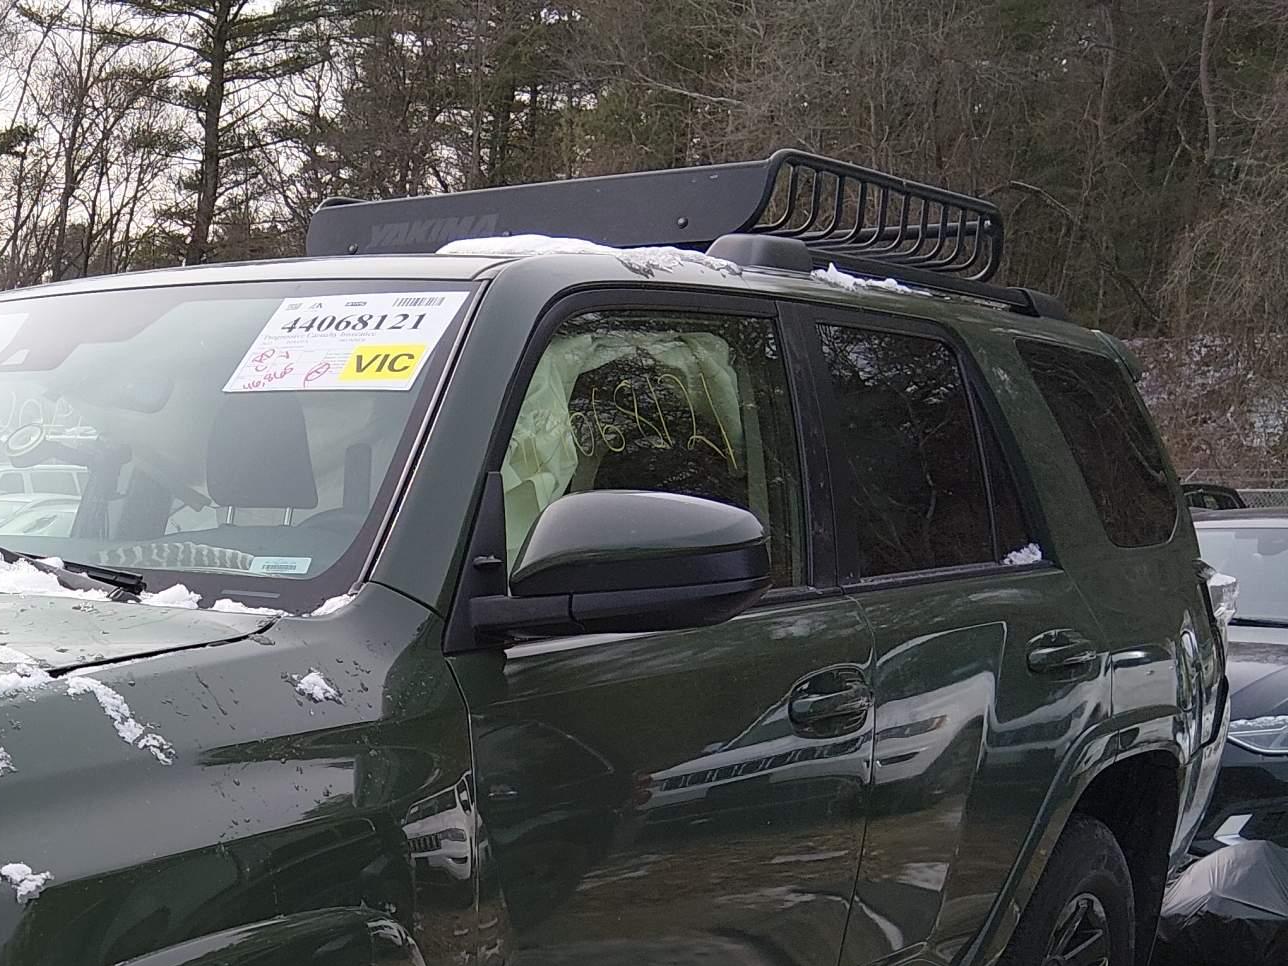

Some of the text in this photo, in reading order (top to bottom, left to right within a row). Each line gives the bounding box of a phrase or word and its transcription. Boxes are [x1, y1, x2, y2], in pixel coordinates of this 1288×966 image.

[367, 213, 499, 248] YAKIMA
[281, 313, 427, 333] 44068121
[355, 353, 415, 373] VIC
